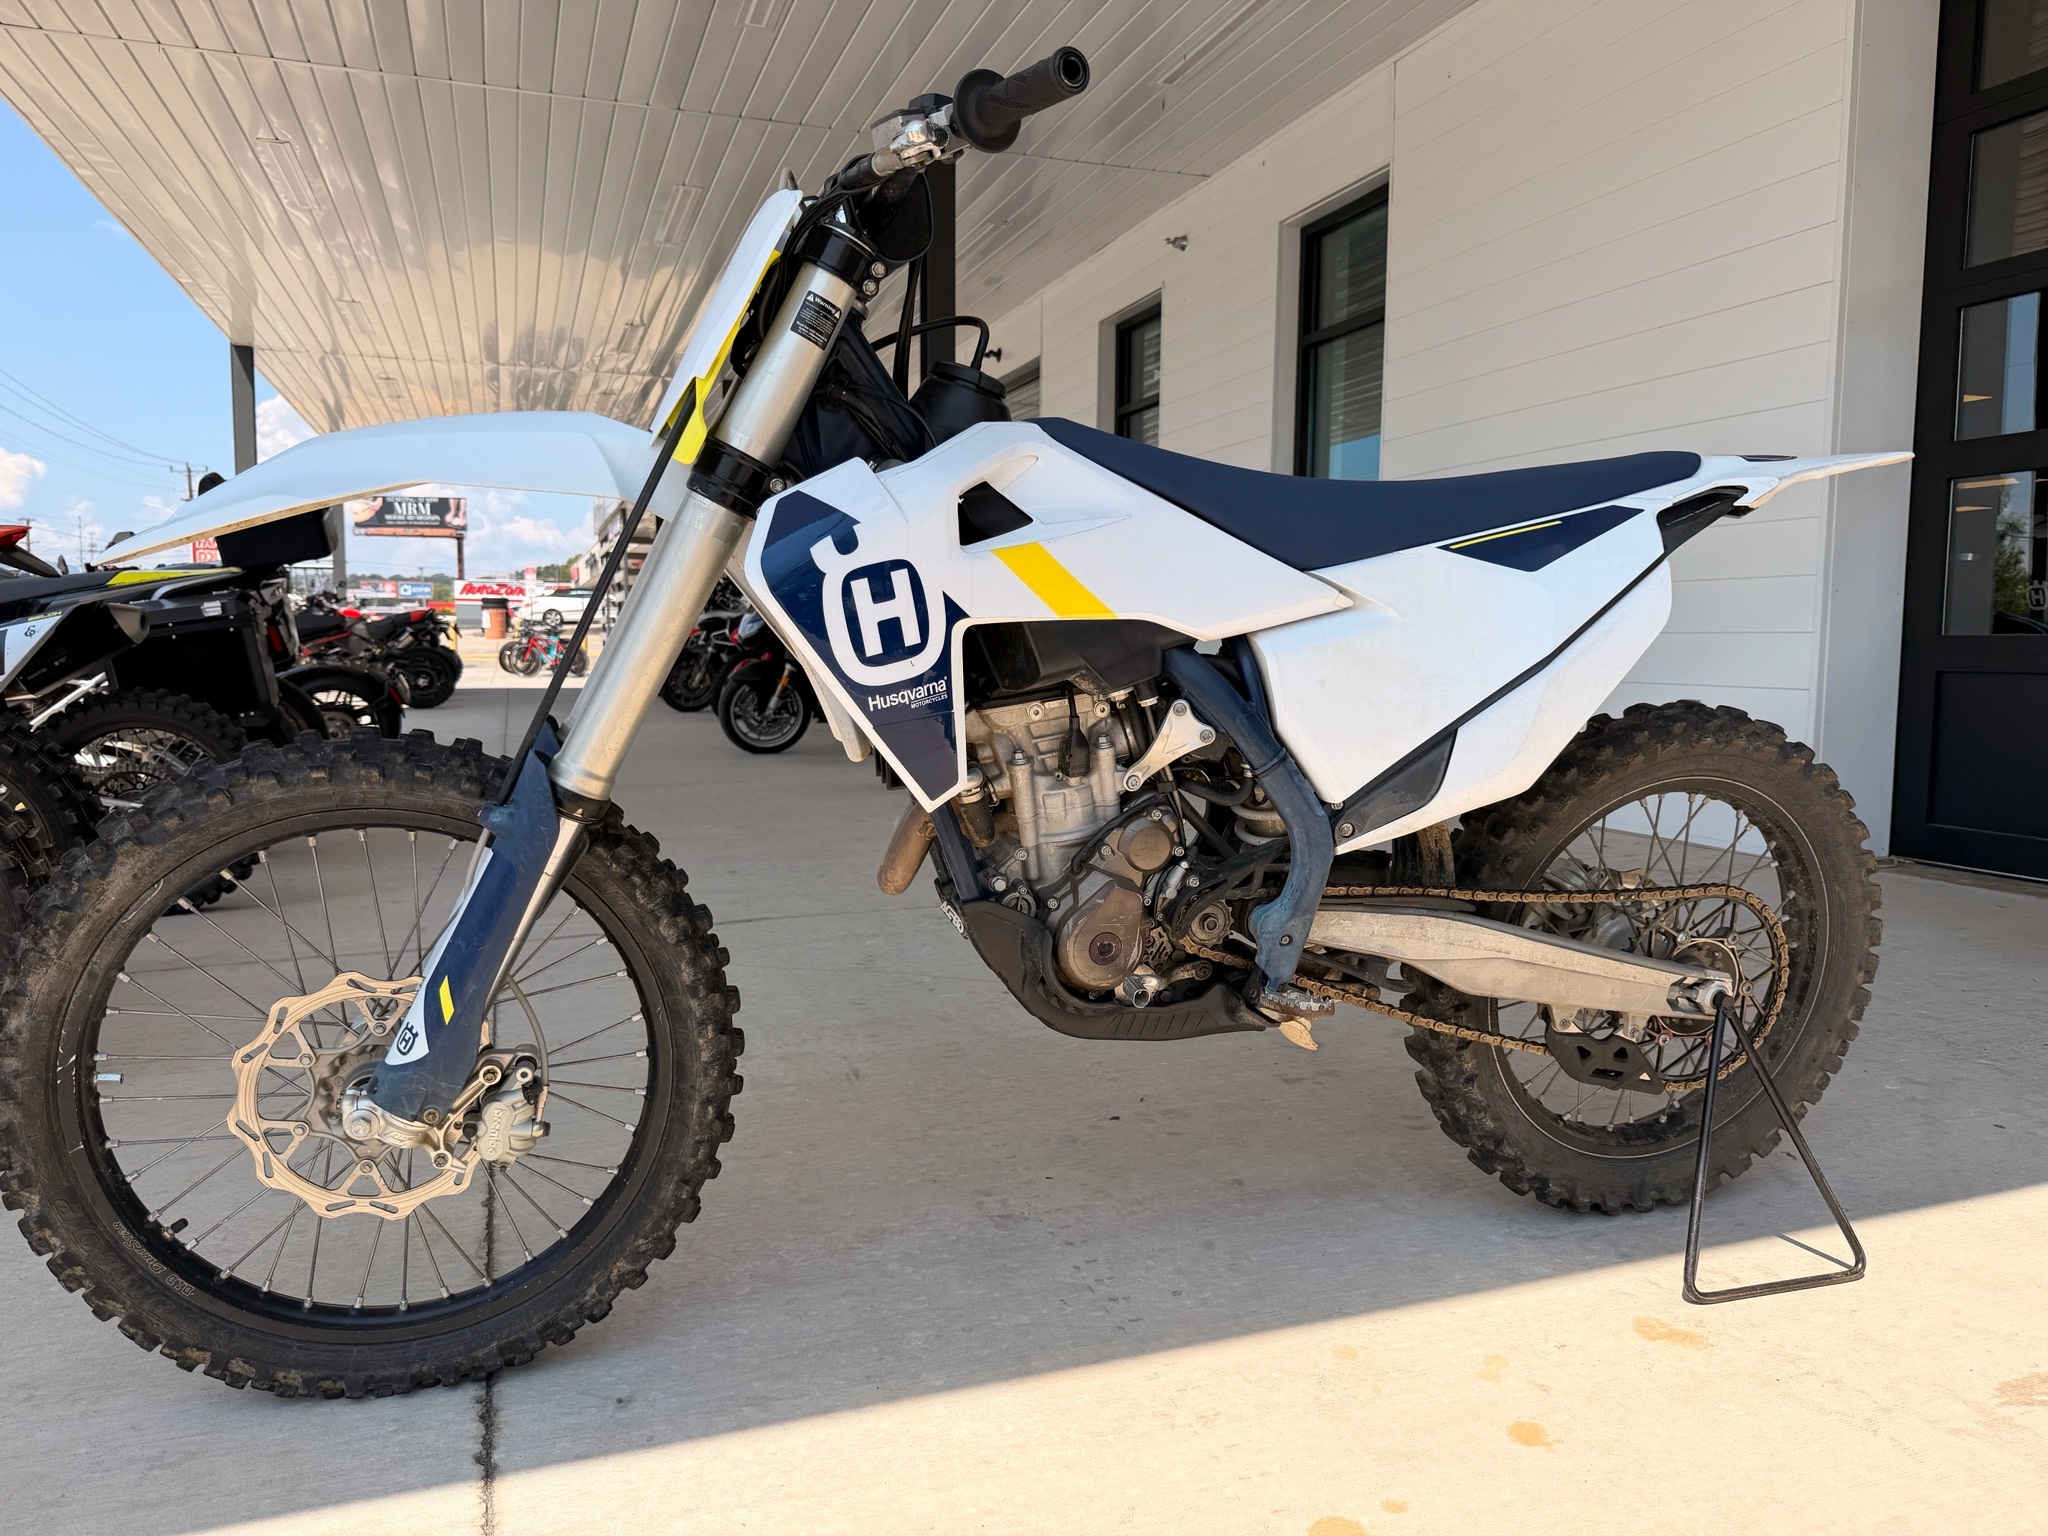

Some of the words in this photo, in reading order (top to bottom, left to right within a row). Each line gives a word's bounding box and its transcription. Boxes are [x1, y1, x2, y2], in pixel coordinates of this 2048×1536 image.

[815, 296, 836, 314] Warning
[394, 502, 431, 516] MRM
[460, 582, 526, 597] AutoZon
[868, 679, 947, 712] Husqvarna
[910, 693, 948, 709] MOTORCYCLES
[488, 1108, 507, 1155] brembo
[165, 1273, 195, 1296] DID
